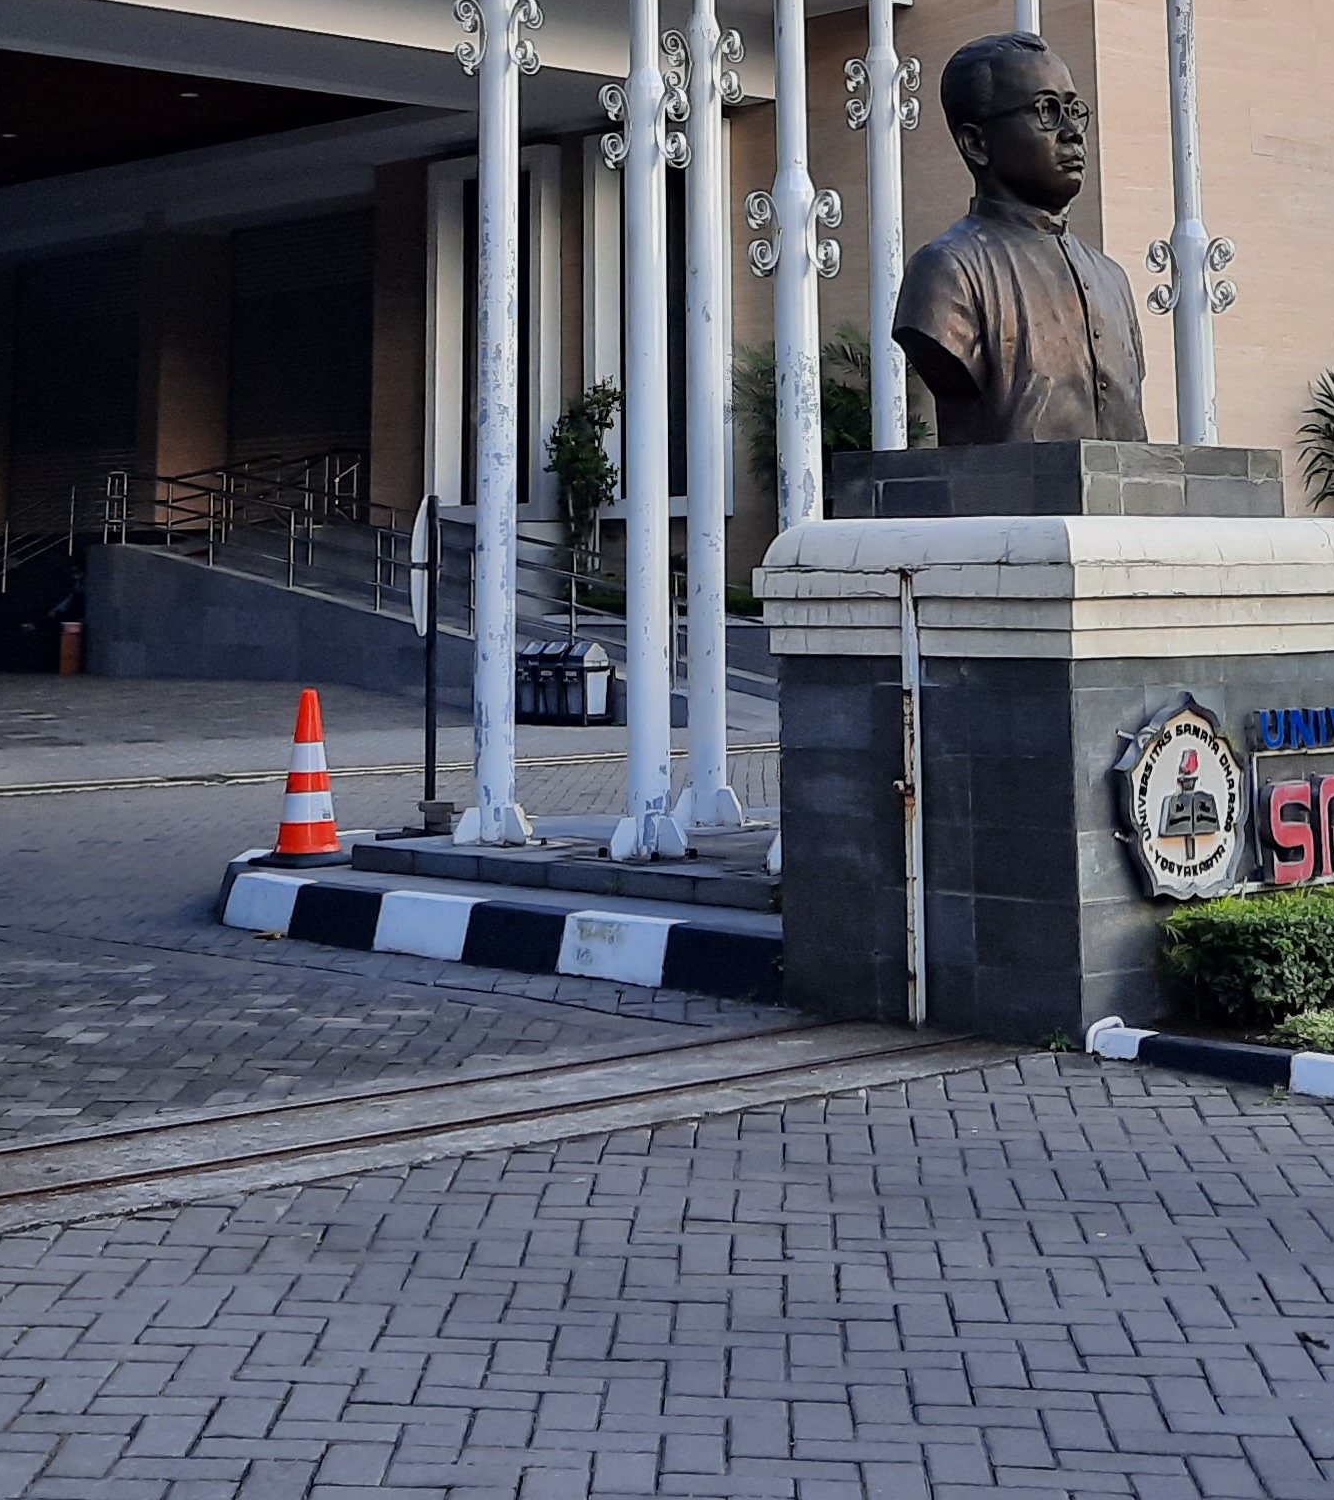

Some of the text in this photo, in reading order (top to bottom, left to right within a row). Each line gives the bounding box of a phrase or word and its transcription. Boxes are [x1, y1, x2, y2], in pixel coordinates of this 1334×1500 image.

[1137, 723, 1237, 842] UNIVERSITAS SANATA DHARMA
[1153, 844, 1227, 878] YOGYAKARTA
